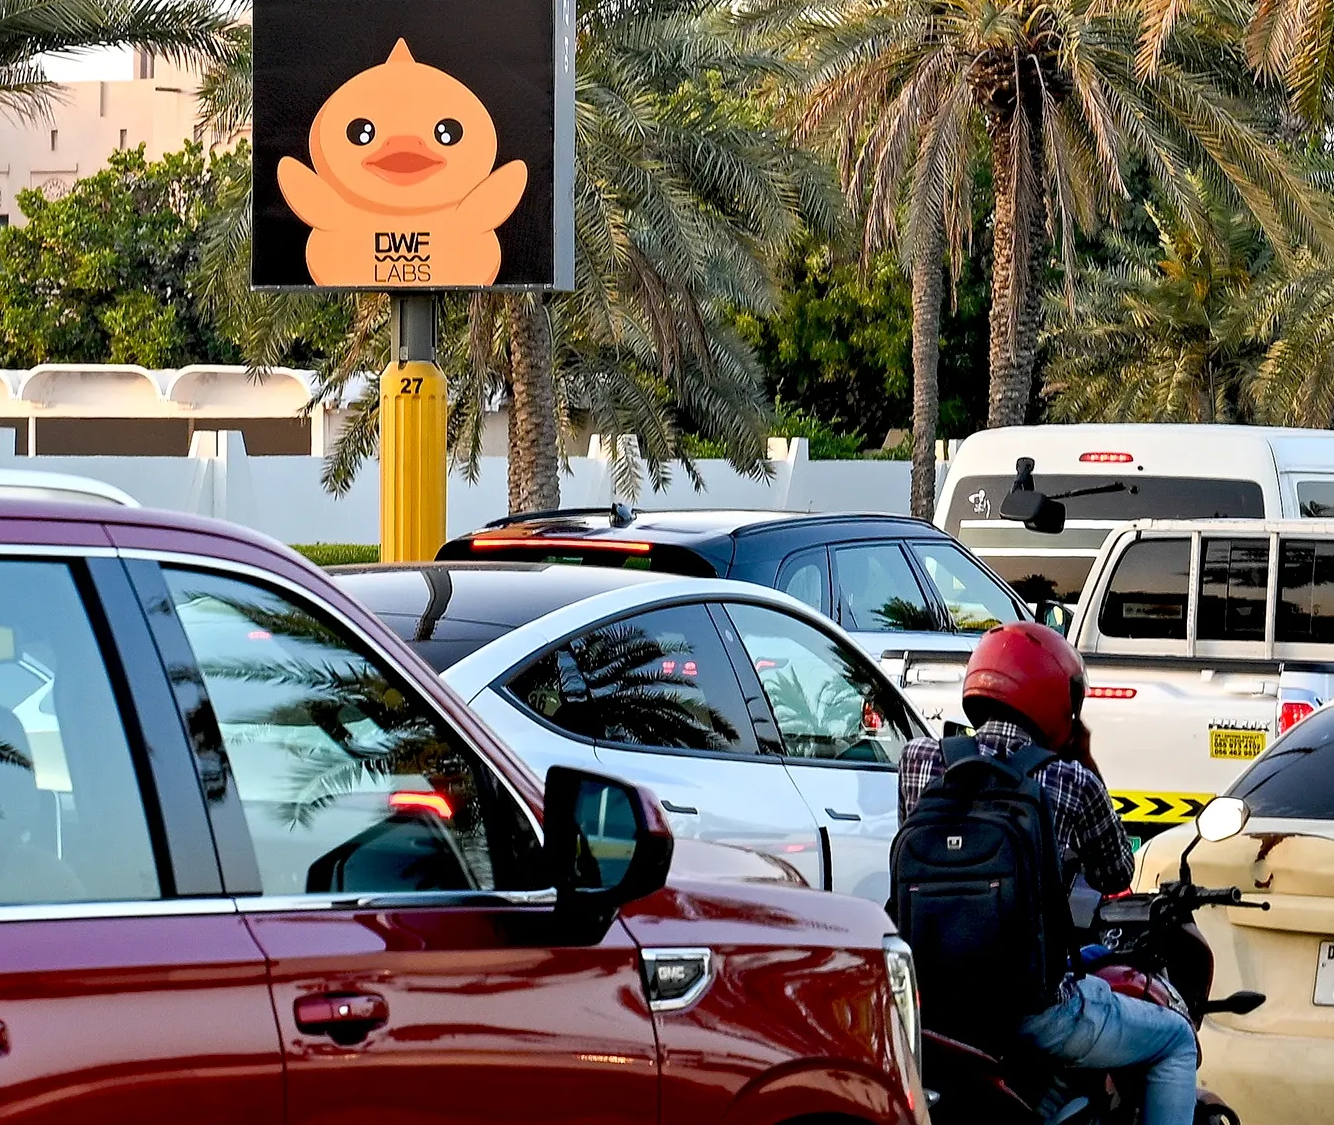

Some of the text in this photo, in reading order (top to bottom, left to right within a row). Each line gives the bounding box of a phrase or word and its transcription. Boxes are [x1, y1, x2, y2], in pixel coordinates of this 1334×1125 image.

[374, 232, 431, 253] DWF
[374, 263, 431, 282] LABS
[400, 377, 424, 395] 27
